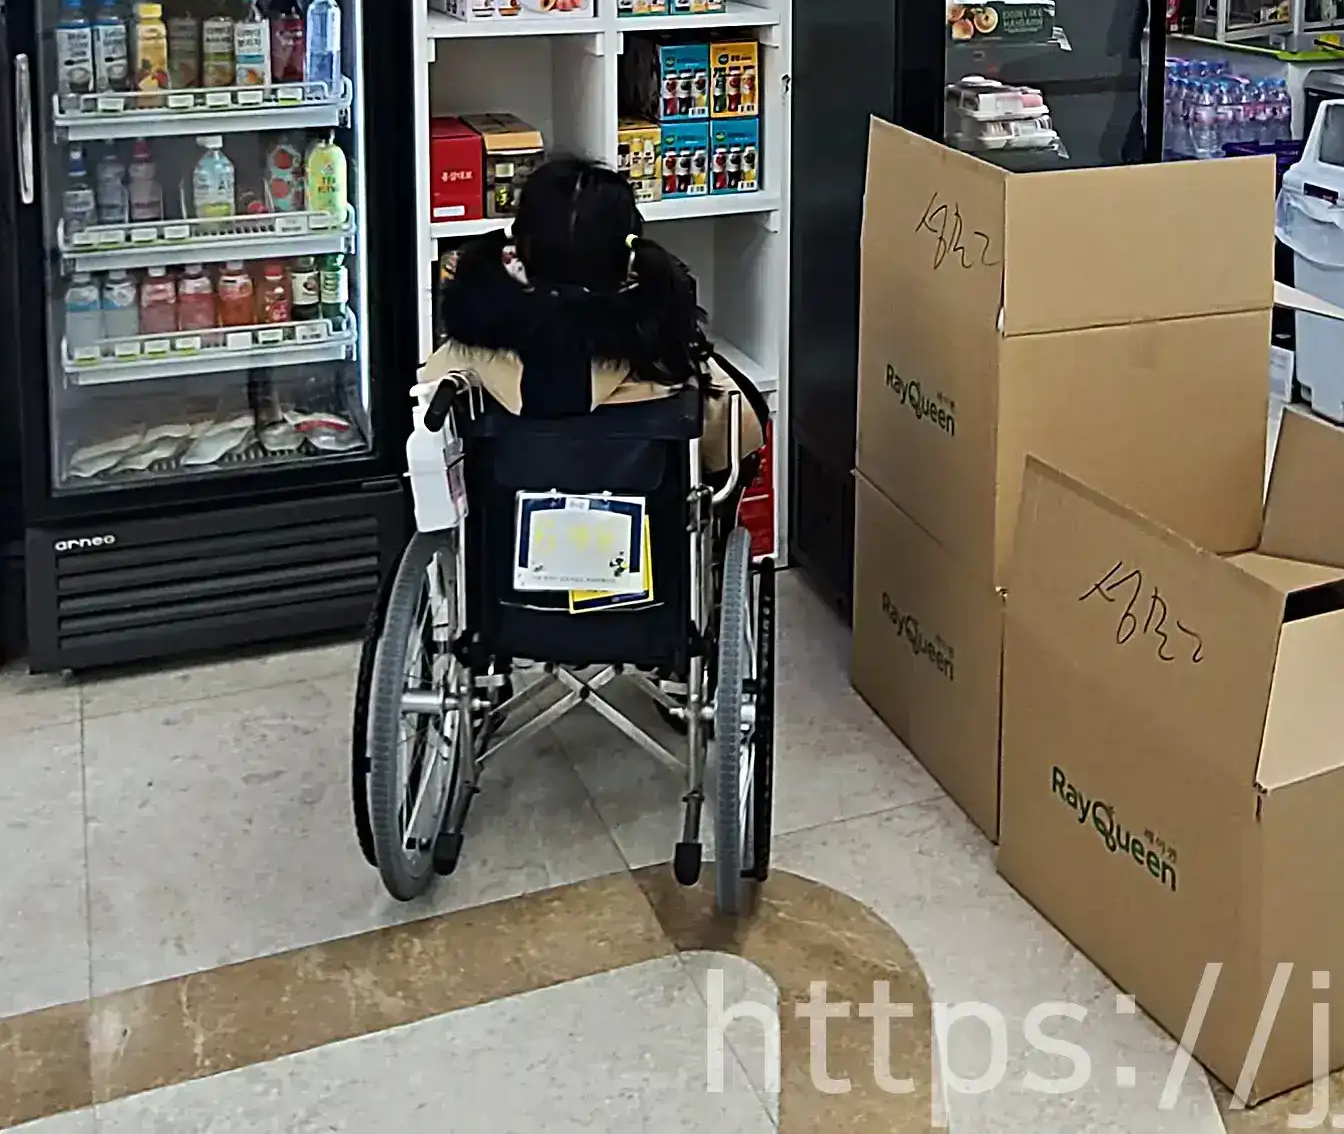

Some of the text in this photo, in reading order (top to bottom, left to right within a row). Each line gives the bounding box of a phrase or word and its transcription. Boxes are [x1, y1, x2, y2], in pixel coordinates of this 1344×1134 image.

[885, 362, 955, 438] RayQueen
[55, 534, 116, 552] arneo
[881, 591, 955, 683] RayQueen
[1051, 765, 1177, 892] RayQueen
